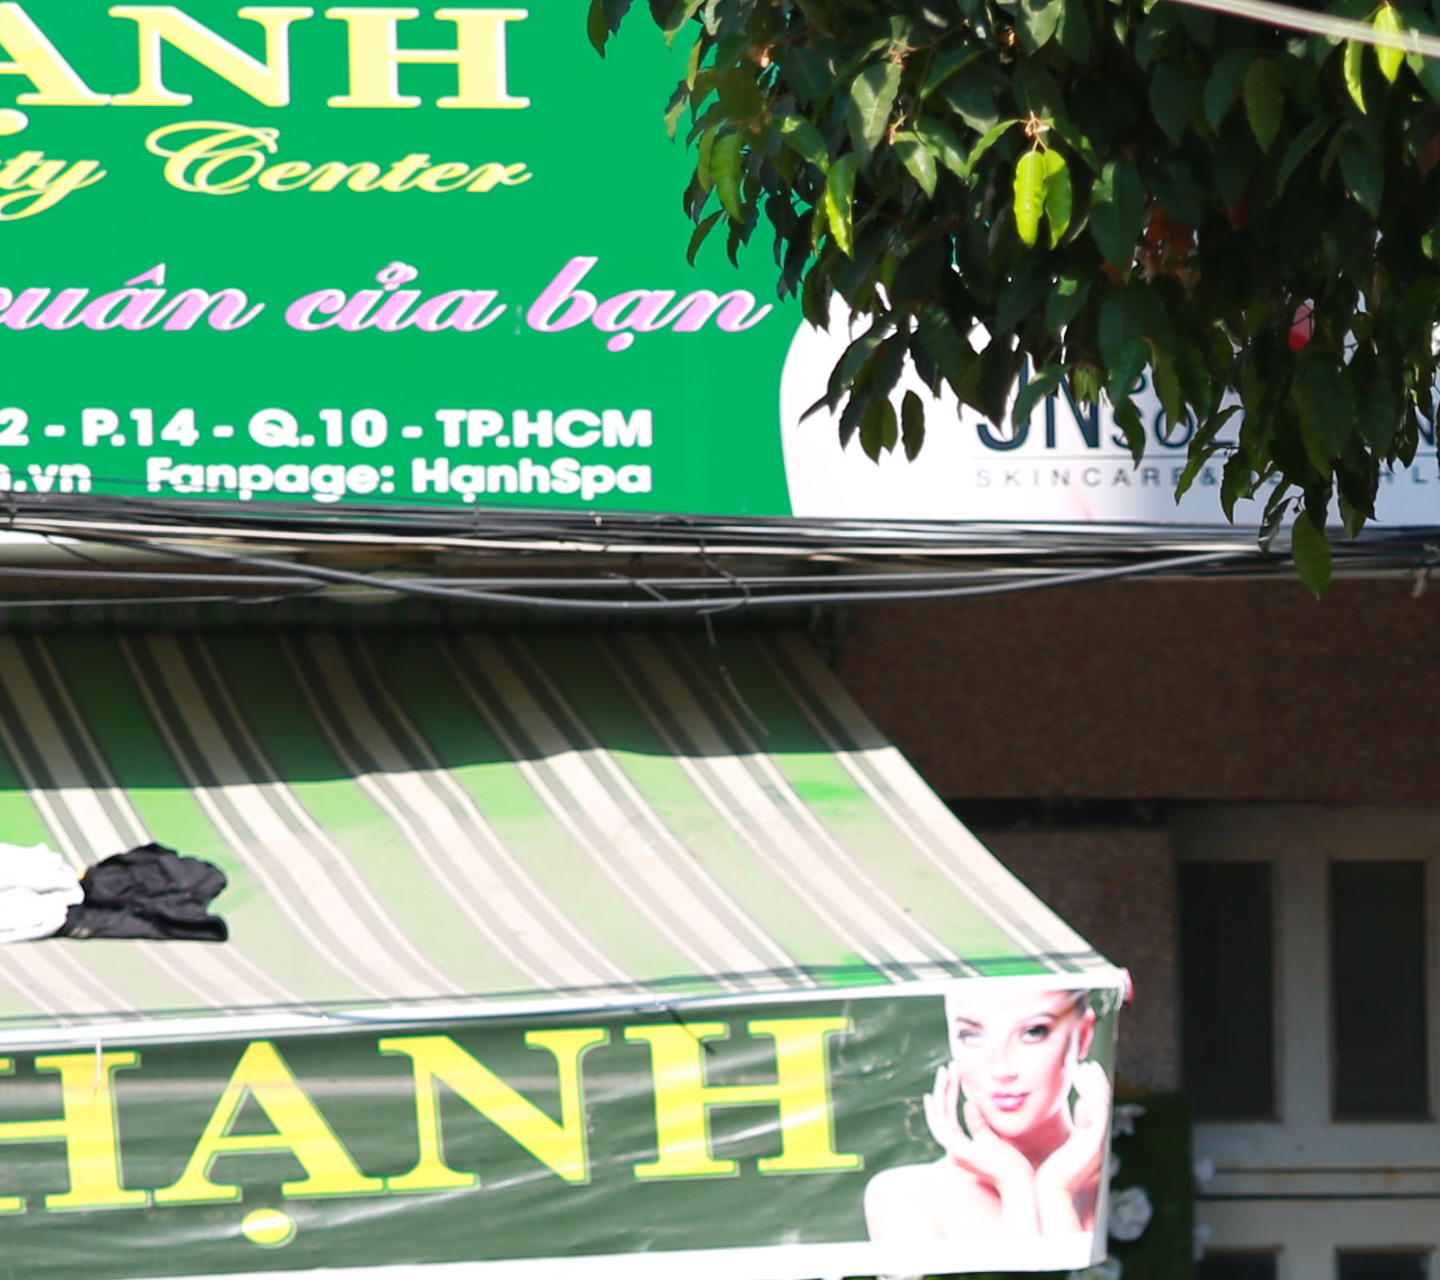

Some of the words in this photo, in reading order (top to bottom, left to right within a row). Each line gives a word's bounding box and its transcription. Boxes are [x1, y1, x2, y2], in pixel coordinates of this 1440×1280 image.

[145, 120, 532, 195] Center
[284, 261, 507, 333] của
[526, 255, 773, 352] bạn
[82, 407, 200, 447] P.14
[248, 408, 389, 448] Q.10
[435, 408, 653, 448] TP.HCM
[146, 457, 395, 503] Fanpage:
[411, 457, 653, 504] HạnhSpa
